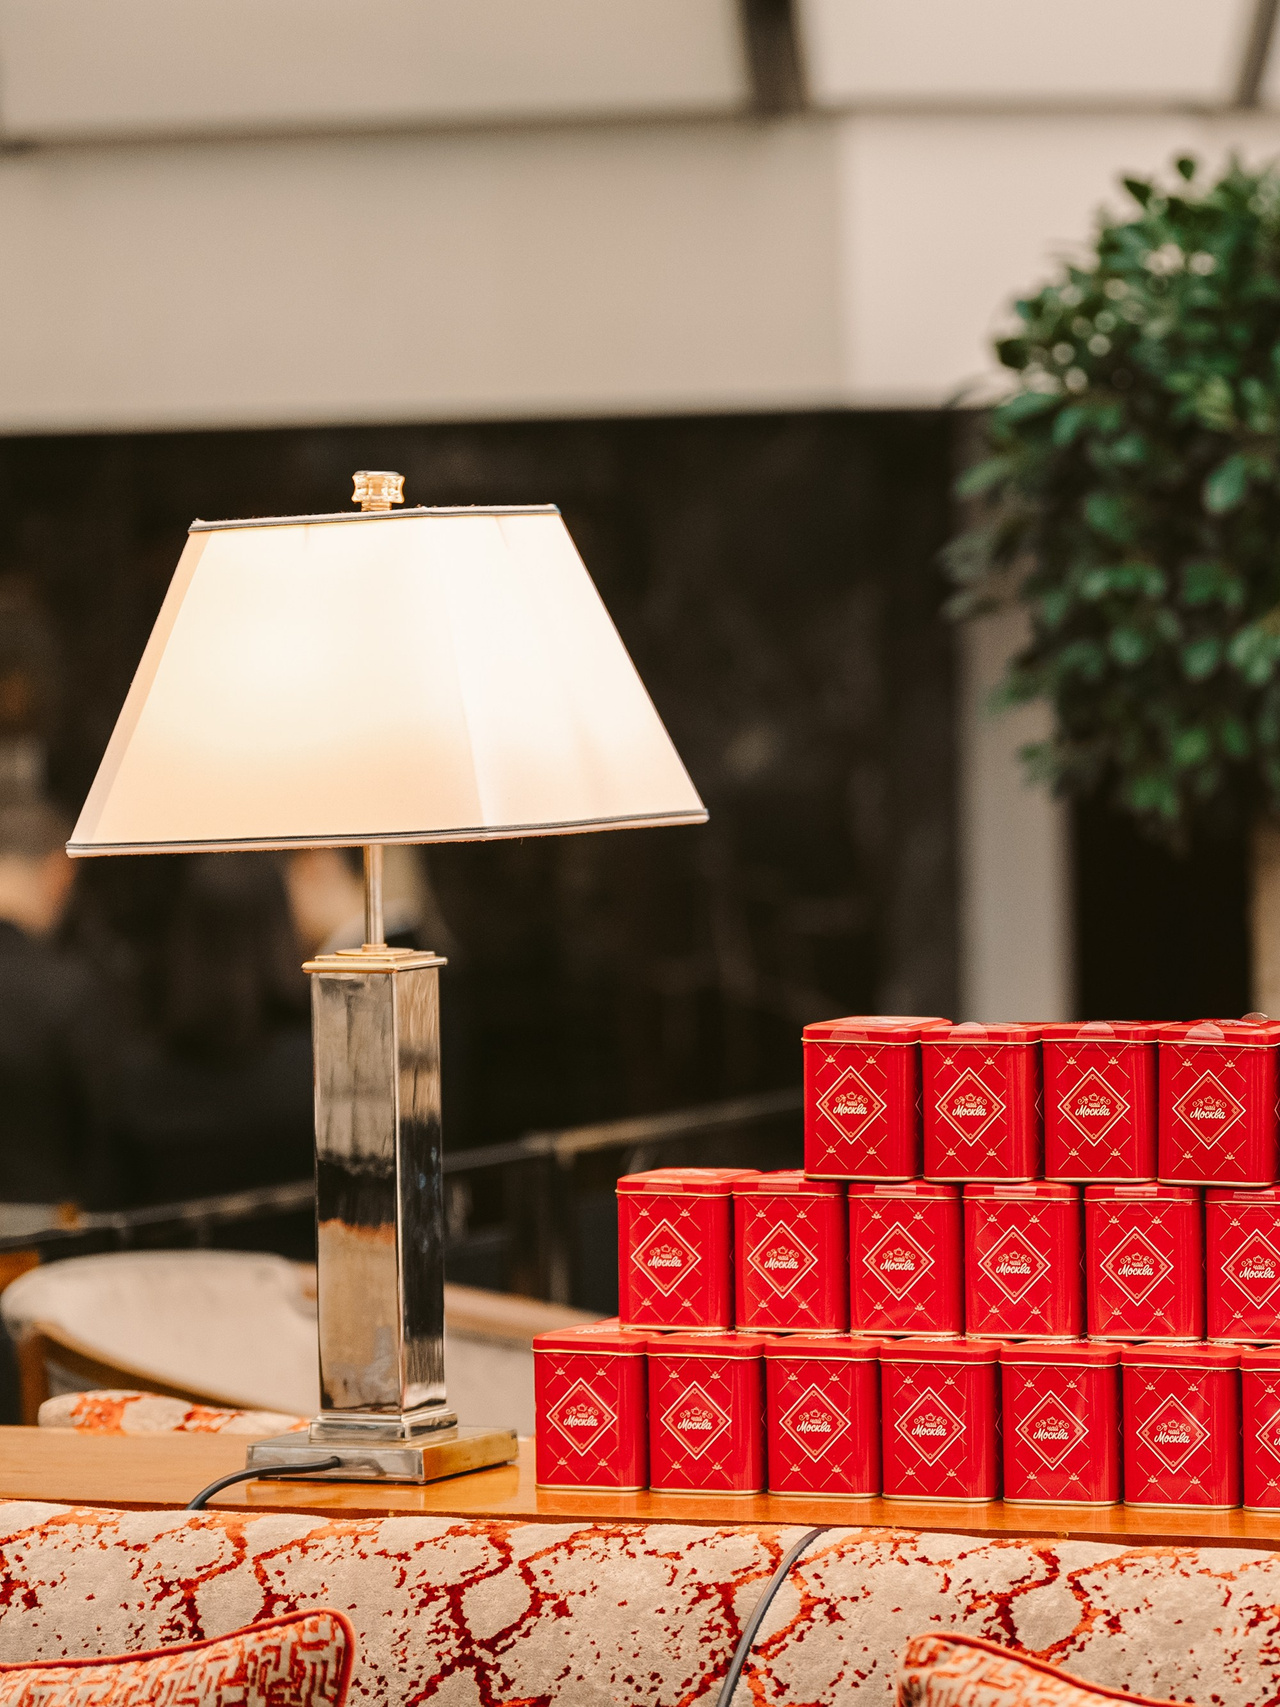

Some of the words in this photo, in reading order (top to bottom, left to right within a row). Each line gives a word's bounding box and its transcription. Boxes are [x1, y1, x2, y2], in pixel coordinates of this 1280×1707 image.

[833, 1103, 867, 1115] Москва
[952, 1105, 986, 1117] Москва
[1076, 1105, 1110, 1117] Москва
[1190, 1108, 1226, 1120] Москва
[648, 1256, 682, 1268] Москва
[764, 1258, 798, 1270] Москва
[880, 1259, 915, 1271] Москва
[996, 1263, 1031, 1275] Москва
[1118, 1264, 1153, 1276] Москва
[1239, 1267, 1275, 1279] Москва
[564, 1415, 598, 1427] Москва
[678, 1419, 712, 1430] Москва
[797, 1421, 831, 1433] Москва
[912, 1425, 946, 1437] Москва
[1033, 1429, 1069, 1440] Москва
[1154, 1432, 1190, 1444] Москва
